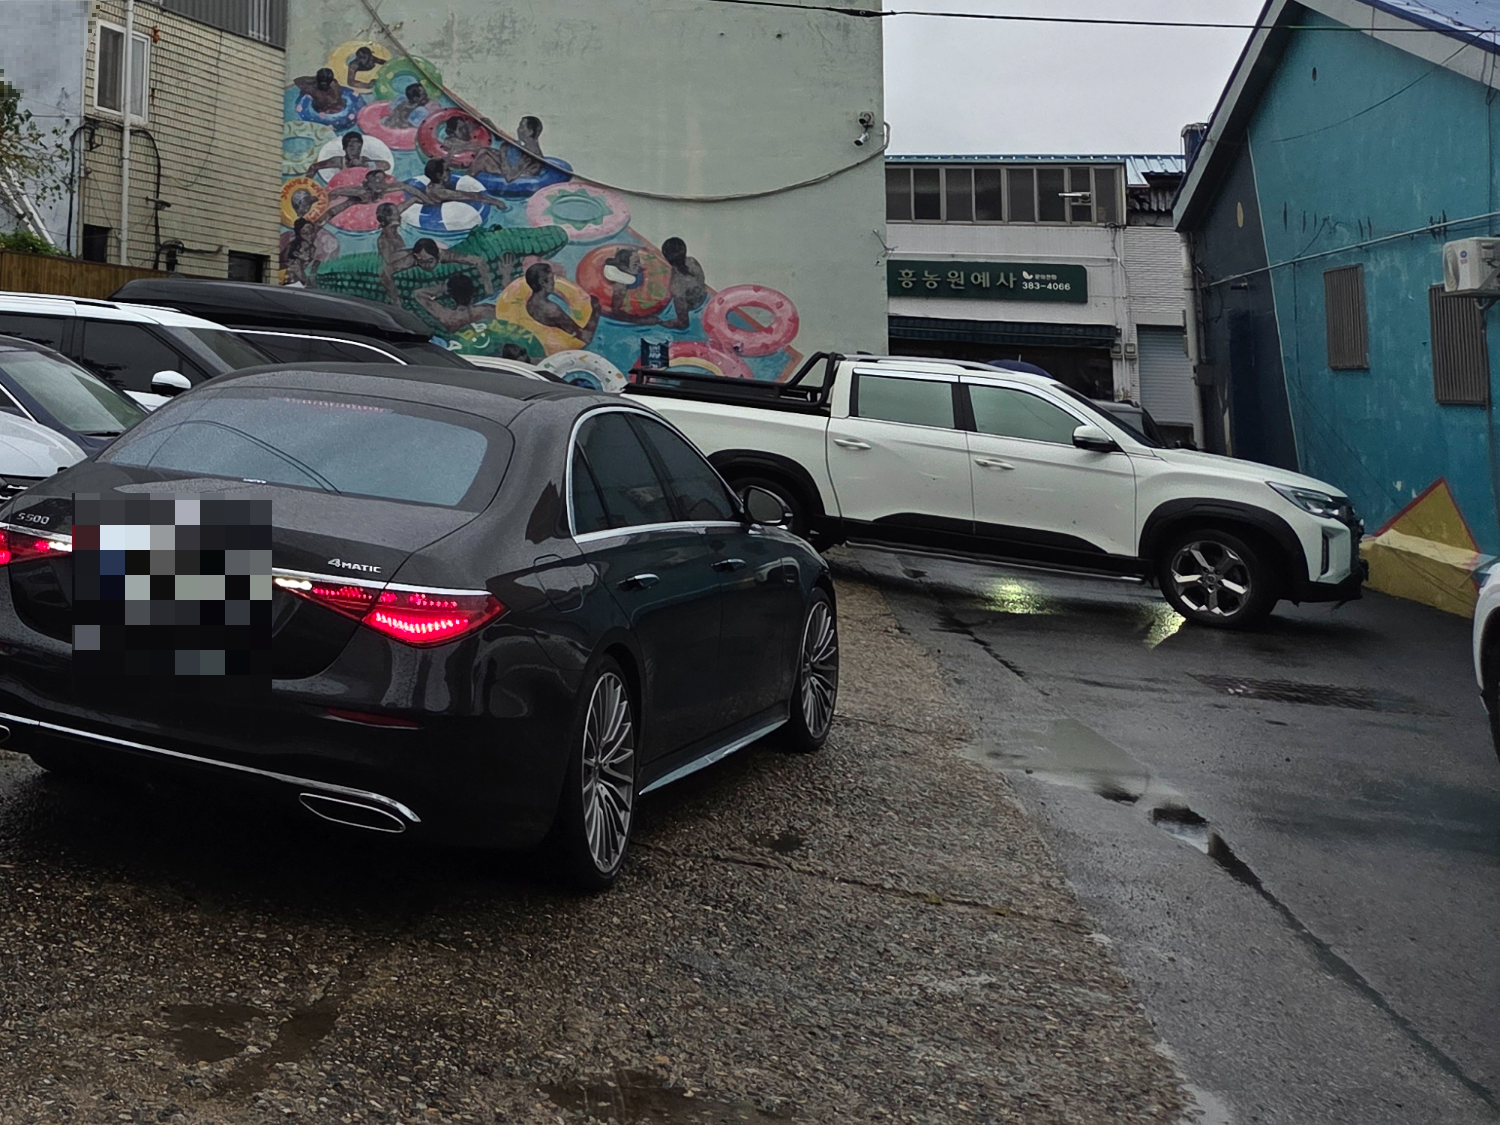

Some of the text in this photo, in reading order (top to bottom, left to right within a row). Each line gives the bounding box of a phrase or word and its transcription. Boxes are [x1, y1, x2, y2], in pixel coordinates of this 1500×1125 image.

[897, 269, 1018, 289] 흥농원예사
[1022, 281, 1071, 291] 383-4066
[327, 558, 382, 574] 4MATIC
